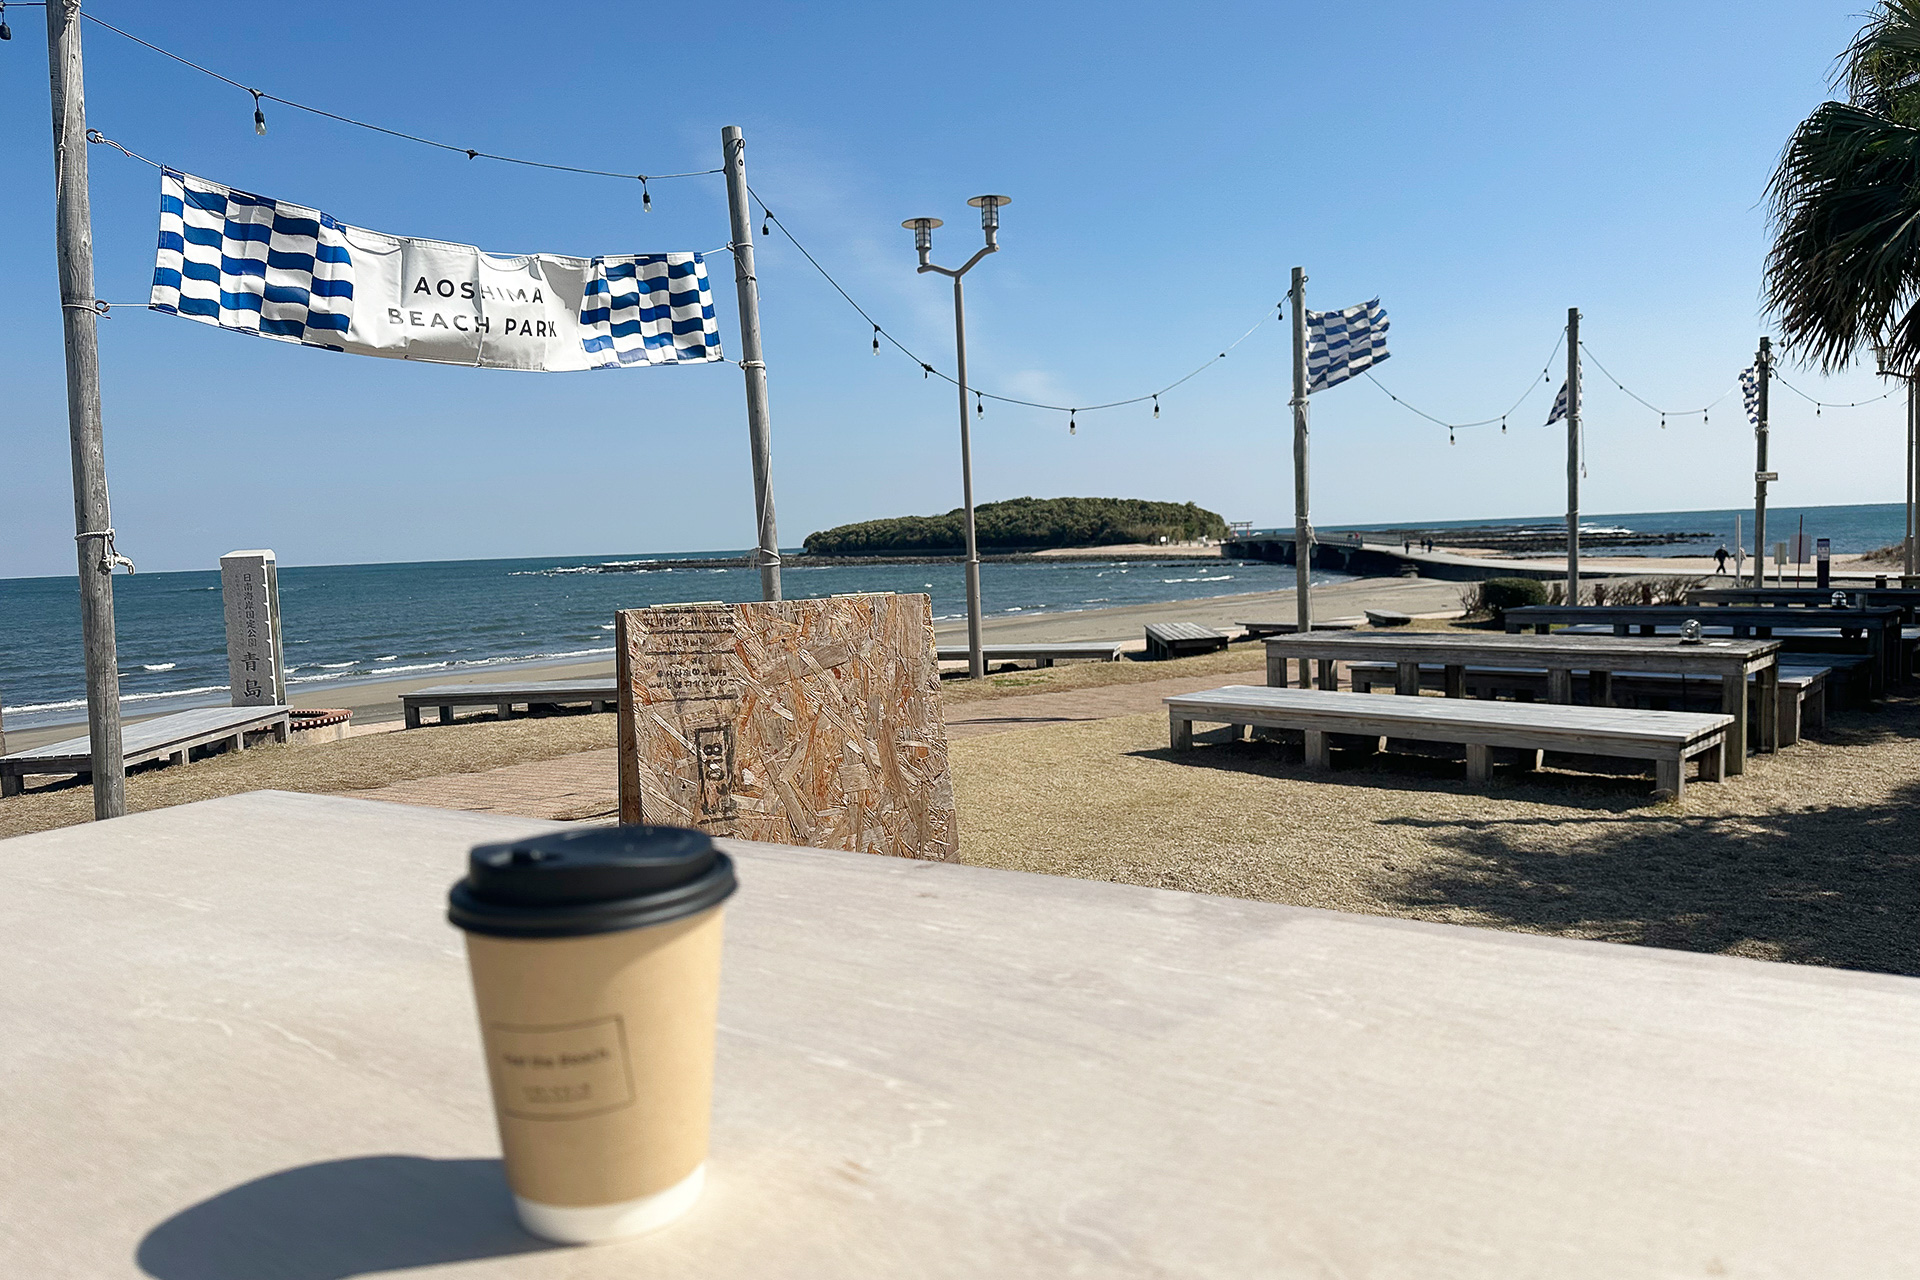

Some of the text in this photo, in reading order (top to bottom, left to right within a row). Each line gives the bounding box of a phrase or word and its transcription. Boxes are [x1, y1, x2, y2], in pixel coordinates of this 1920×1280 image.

[413, 276, 544, 304] AOSHIMA
[388, 308, 557, 338] BEACH PARK
[241, 651, 262, 699] 青島
